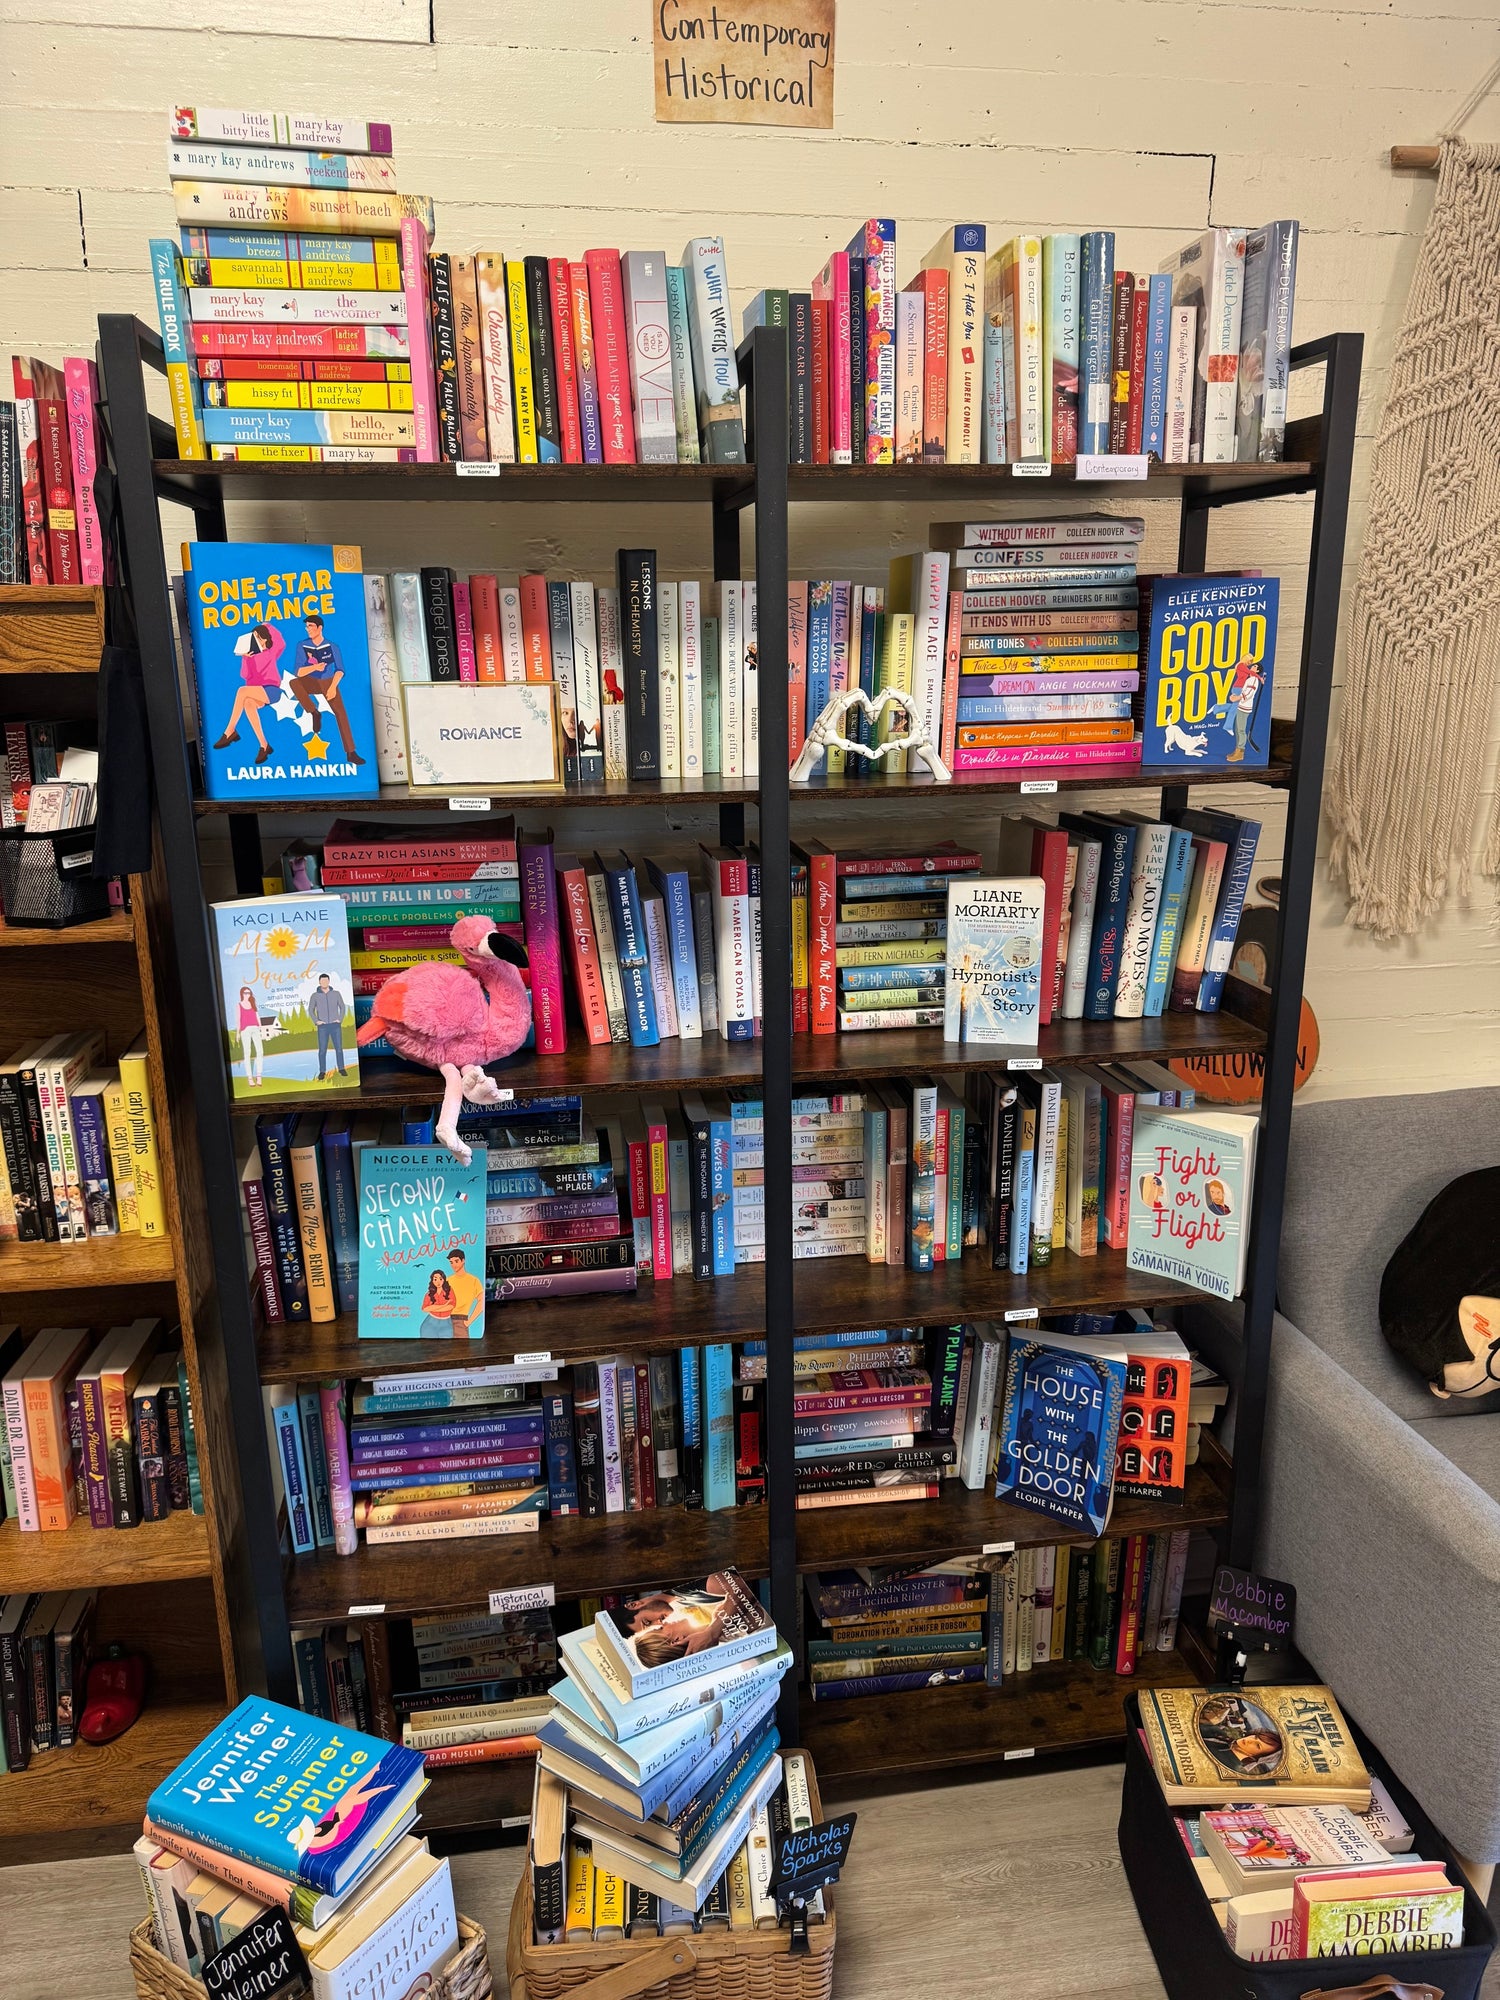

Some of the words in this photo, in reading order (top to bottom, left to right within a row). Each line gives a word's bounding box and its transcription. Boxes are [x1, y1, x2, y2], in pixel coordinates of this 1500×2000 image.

[660, 0, 831, 68] Contemporary
[665, 57, 813, 107] Historical
[222, 125, 247, 139] bitty
[251, 127, 270, 138] lies
[242, 113, 269, 125] little
[294, 118, 322, 132] mary
[325, 120, 343, 134] kay
[295, 131, 341, 144] andrews
[188, 152, 218, 167] mary
[221, 153, 241, 169] kay
[248, 157, 294, 170] andrews
[305, 166, 366, 180] weekenders
[310, 199, 350, 213] sunset
[355, 202, 392, 217] beach
[229, 234, 280, 245] savannah
[247, 246, 281, 257] breeze
[964, 258, 976, 278] PS:
[1062, 251, 1075, 304] Belong
[1223, 260, 1236, 292] Jude
[159, 277, 177, 312] RULE
[434, 258, 449, 313] LEASE
[703, 264, 722, 304] WHAT
[314, 307, 381, 319] newcomer
[938, 286, 946, 318] NEXT
[964, 296, 976, 320] Hate
[1064, 309, 1072, 321] to
[165, 315, 182, 353] BOOK
[709, 307, 727, 354] HAPPENS
[927, 301, 935, 353] HAVANA
[963, 324, 974, 340] You
[1222, 296, 1237, 350] Deveraux
[439, 324, 453, 359] LOVE
[488, 310, 503, 369] Chasing
[937, 324, 945, 358] YEAR
[1063, 328, 1075, 350] Me
[461, 335, 476, 422] Approximately
[714, 357, 730, 386] NOW
[173, 372, 184, 403] SARAH
[491, 371, 505, 423] Lucky
[582, 378, 592, 402] JACI
[178, 406, 191, 439] ADAMS
[343, 429, 394, 440] summer
[350, 415, 385, 431] hello,
[585, 405, 595, 451] BURTON
[962, 406, 970, 448] CONNOLLY
[1086, 460, 1139, 476] Contemporary
[81, 486, 89, 513] Rosie
[84, 518, 92, 549] Danan
[979, 528, 1022, 540] WITHOUT
[1026, 528, 1056, 539] MERIT
[1066, 529, 1095, 538] COLLEEN
[1098, 528, 1124, 536] HOOVER
[974, 552, 1044, 564] CONFESS
[199, 570, 332, 605] ONE-STAR
[631, 579, 639, 595] IN
[641, 561, 651, 611] LESSONS
[1168, 592, 1198, 606] ELLE
[1202, 585, 1266, 602] KENNEDY
[203, 594, 336, 628] ROMANCE
[430, 576, 445, 626] bridget
[1164, 606, 1212, 622] SARINA
[1217, 601, 1266, 614] BOWEN
[632, 598, 642, 658] CHEMISTRY
[971, 616, 978, 628] IT
[980, 616, 1003, 627] ENDS
[1006, 615, 1033, 627] WITH
[1035, 615, 1051, 626] US
[432, 629, 449, 674] jones
[968, 639, 995, 649] HEART
[998, 638, 1024, 648] BONES
[1160, 615, 1267, 675] GOOD
[1156, 669, 1237, 728] BOY
[440, 726, 522, 741] ROMANCE
[227, 766, 287, 781] LAURA
[290, 764, 358, 778] HANKIN
[453, 799, 487, 807] Contemporary
[332, 851, 374, 860] CRAZY
[377, 849, 408, 859] RICH
[411, 848, 455, 858] ASIANS
[1233, 838, 1255, 874] DIANA
[973, 890, 1022, 903] LIANE
[1168, 893, 1177, 904] IF
[1221, 875, 1246, 928] PALMER
[233, 913, 275, 925] KACI
[282, 910, 329, 923] LANE
[955, 905, 1040, 919] MORIARTY
[1166, 906, 1175, 926] THE
[732, 907, 743, 975] AMERICAN
[1160, 930, 1173, 955] SHOE
[379, 952, 427, 963] Shopaholic
[973, 961, 990, 971] the
[1154, 957, 1170, 984] FITS
[243, 958, 316, 988] Squad
[952, 968, 1037, 984] Hypnotist's
[734, 978, 744, 1016] ROYALS
[981, 984, 1016, 996] Love
[993, 999, 1035, 1014] Story
[128, 1092, 142, 1113] carly
[128, 1114, 149, 1154] phillips
[1003, 1114, 1014, 1166] DANIELLE
[267, 1136, 279, 1164] Jodi
[374, 1155, 429, 1164] NICOLE
[556, 1172, 592, 1182] SHELTER
[1155, 1147, 1220, 1185] Fight
[270, 1168, 288, 1213] Picoult
[365, 1176, 445, 1215] SECOND
[566, 1181, 592, 1190] PLACE
[1000, 1168, 1011, 1199] STEEL
[1176, 1192, 1200, 1208] or
[363, 1203, 461, 1249] CHANCE
[1152, 1208, 1226, 1249] Flight
[381, 1232, 478, 1267] vacation
[571, 1248, 609, 1266] TRIBUTE
[1132, 1252, 1192, 1281] SAMANTHA
[1195, 1270, 1229, 1295] YOUNG
[944, 1337, 960, 1372] PLAIN
[405, 1383, 443, 1391] HIGGINS
[445, 1379, 473, 1387] CLARK
[1056, 1365, 1074, 1377] THE
[940, 1374, 953, 1406] JANE
[1024, 1372, 1103, 1409] HOUSE
[4, 1389, 22, 1424] DATING
[1045, 1407, 1075, 1422] WITH
[14, 1427, 23, 1442] DR.
[108, 1405, 124, 1441] FLOCK
[822, 1423, 857, 1431] Gregory
[864, 1417, 908, 1427] DAWNLANDS
[1047, 1430, 1068, 1444] THE
[17, 1445, 25, 1460] DIL
[1008, 1440, 1100, 1483] GOLDEN
[1019, 1466, 1086, 1504] DOOR
[1016, 1491, 1046, 1506] ELODIE
[1050, 1502, 1083, 1521] HARPER
[493, 1589, 544, 1606] Historical
[502, 1599, 550, 1611] Romance
[858, 1594, 898, 1606] Lucinda
[901, 1592, 926, 1603] Riley
[1219, 1571, 1286, 1610] Debbie
[1215, 1599, 1290, 1634] Macomber
[667, 1651, 713, 1674] NICHOLAS
[676, 1664, 708, 1679] SPARKS
[412, 1732, 457, 1747] LOVESICK
[1160, 1693, 1183, 1737] GILBERT
[1173, 1736, 1198, 1784] MORRIS
[181, 1711, 276, 1804] Jennifer
[208, 1725, 297, 1803] Weiner
[451, 1749, 484, 1759] MUSLIM
[254, 1736, 345, 1828] Summer
[254, 1774, 289, 1801] The
[302, 1750, 369, 1814] Place
[156, 1814, 195, 1838] Jennifer
[198, 1831, 234, 1854] Weiner
[780, 1822, 850, 1858] Nicholas
[781, 1842, 842, 1876] Sparks
[1345, 1907, 1430, 1937] DEBBIE
[206, 1919, 283, 1989] Jennifer
